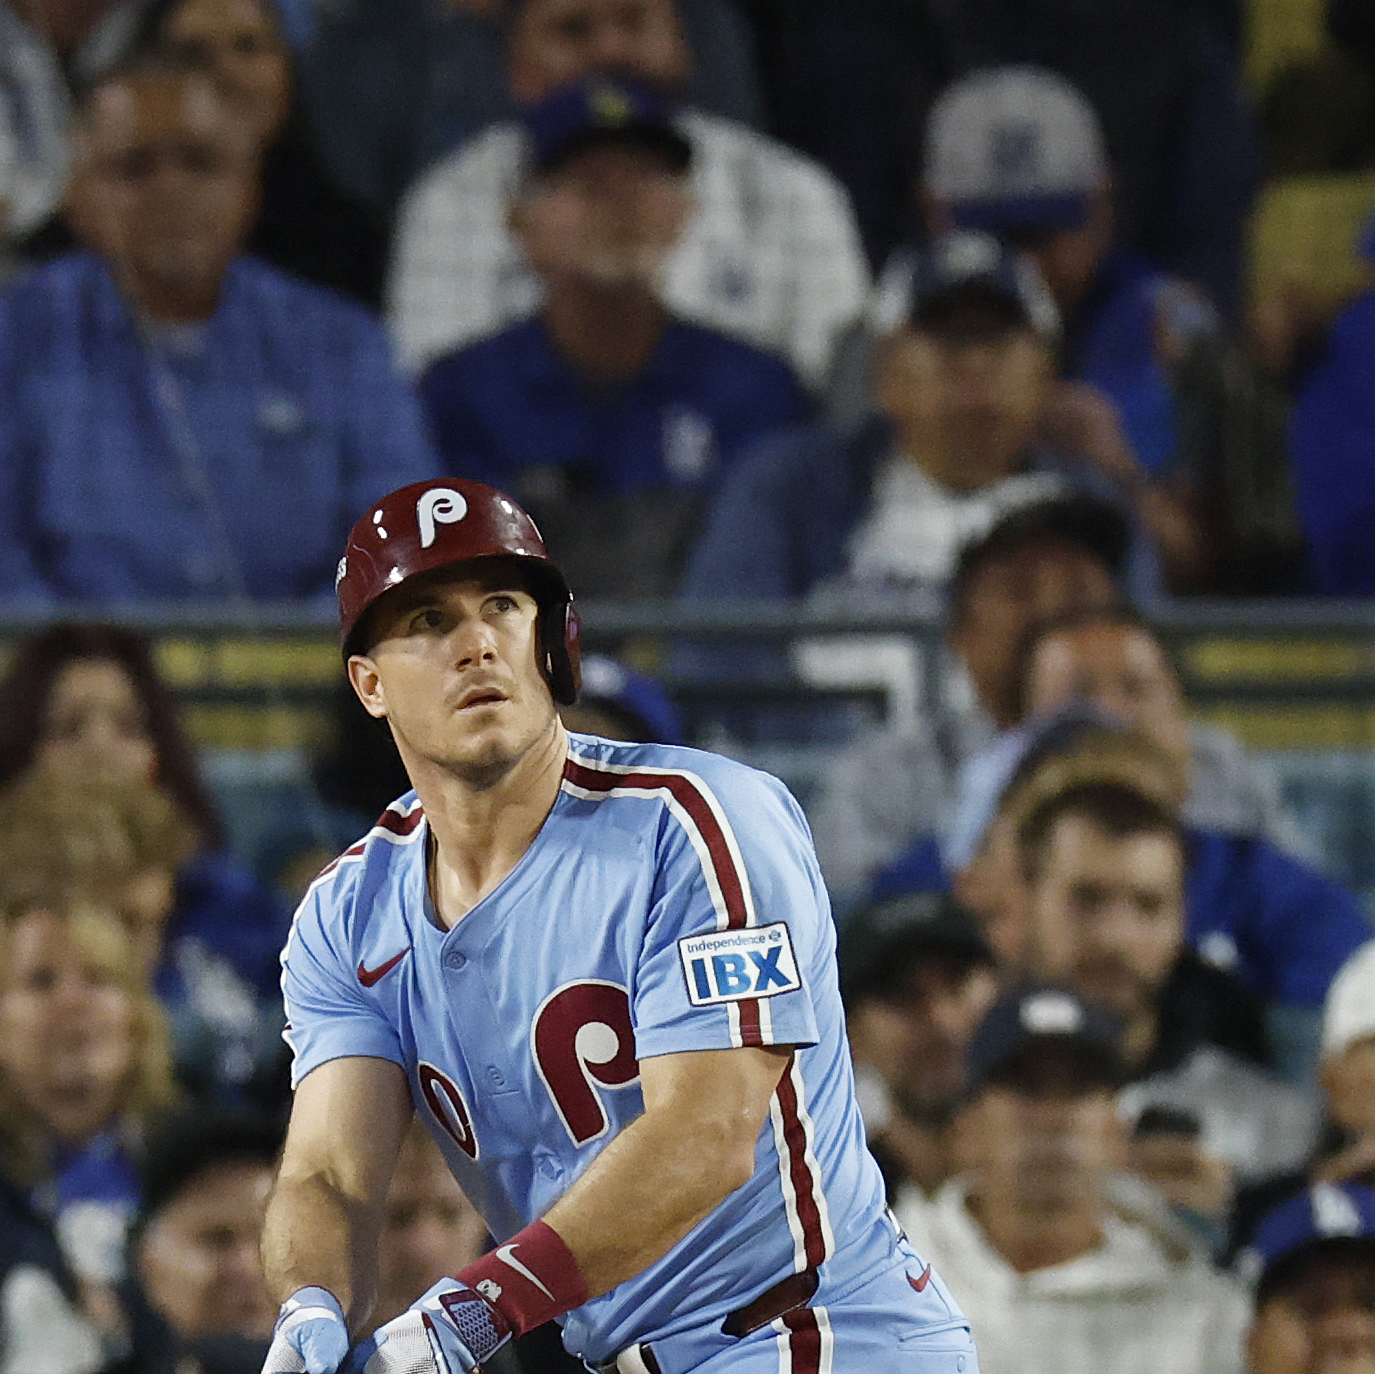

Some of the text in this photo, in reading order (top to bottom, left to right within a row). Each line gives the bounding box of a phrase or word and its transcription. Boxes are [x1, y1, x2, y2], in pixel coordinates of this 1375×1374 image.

[416, 487, 468, 549] P
[691, 945, 792, 1000] IBX
[530, 978, 642, 1149] P
